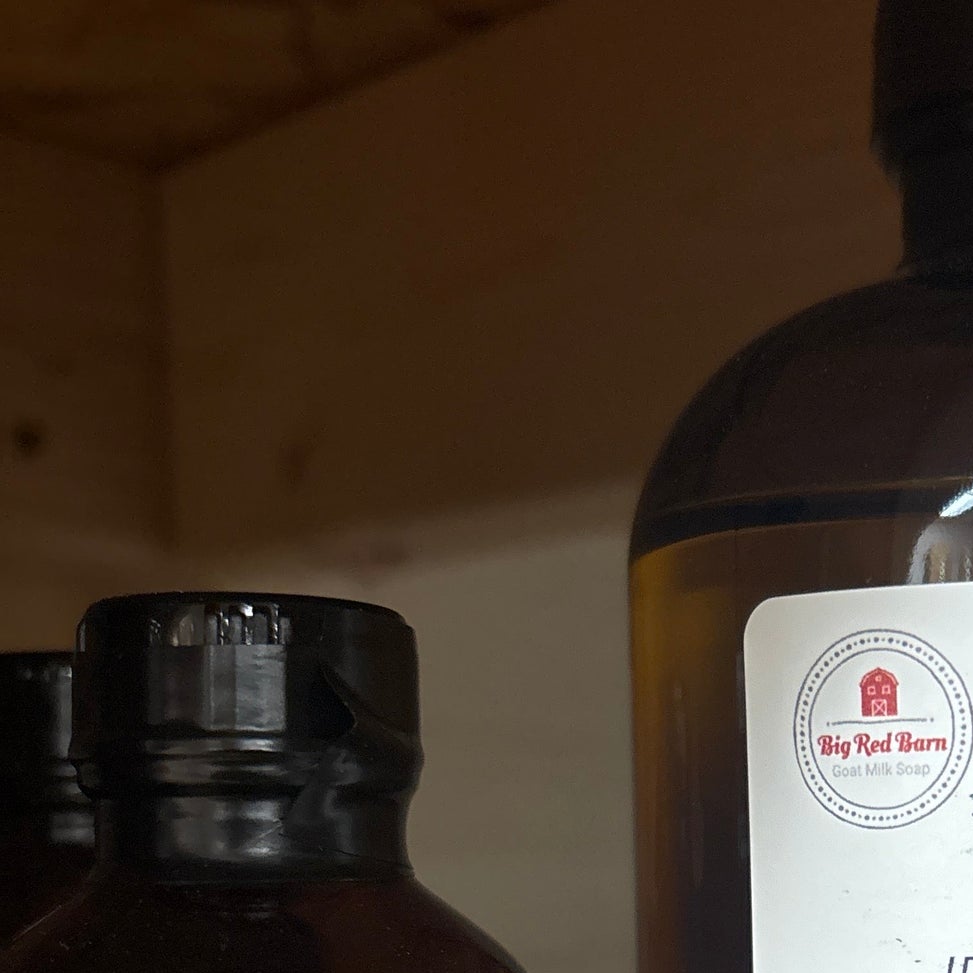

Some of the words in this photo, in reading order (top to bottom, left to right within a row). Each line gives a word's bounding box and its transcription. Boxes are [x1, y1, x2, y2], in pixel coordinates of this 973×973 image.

[817, 733, 852, 760] Big
[853, 731, 893, 757] Red
[895, 731, 947, 753] Barn
[832, 764, 862, 778] Goat
[865, 763, 892, 777] Milk
[895, 761, 930, 777] Soap
